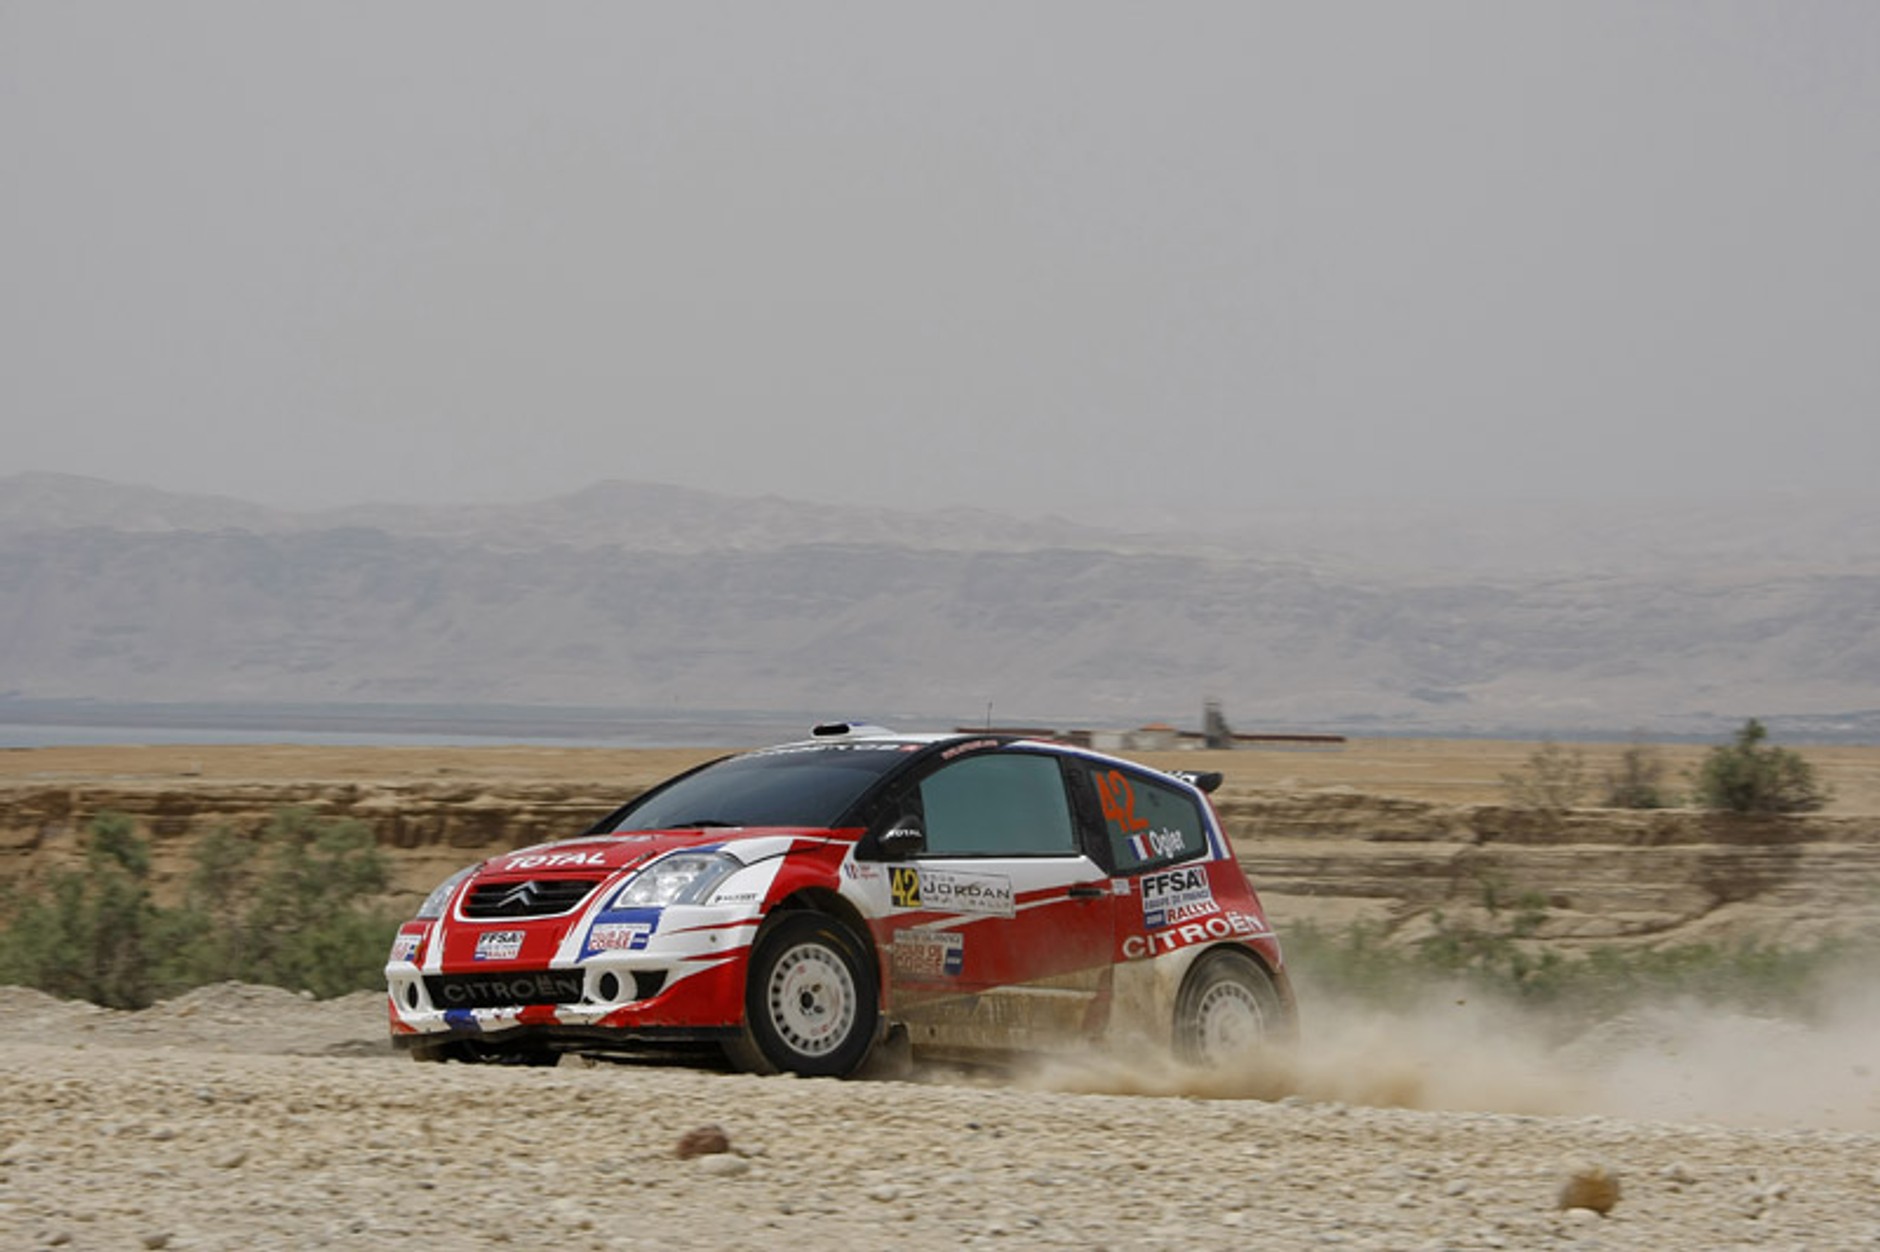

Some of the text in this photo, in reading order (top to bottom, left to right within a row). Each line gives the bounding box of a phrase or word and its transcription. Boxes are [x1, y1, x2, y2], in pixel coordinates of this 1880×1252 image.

[1096, 770, 1149, 833] 42
[505, 853, 605, 870] TOTAL
[892, 868, 921, 907] 42
[923, 881, 1010, 898] JORDAN
[1143, 869, 1202, 898] FFSA
[1168, 900, 1217, 922] RALLYE
[1123, 911, 1264, 957] CITROËN
[443, 974, 579, 1002] CITROËN
